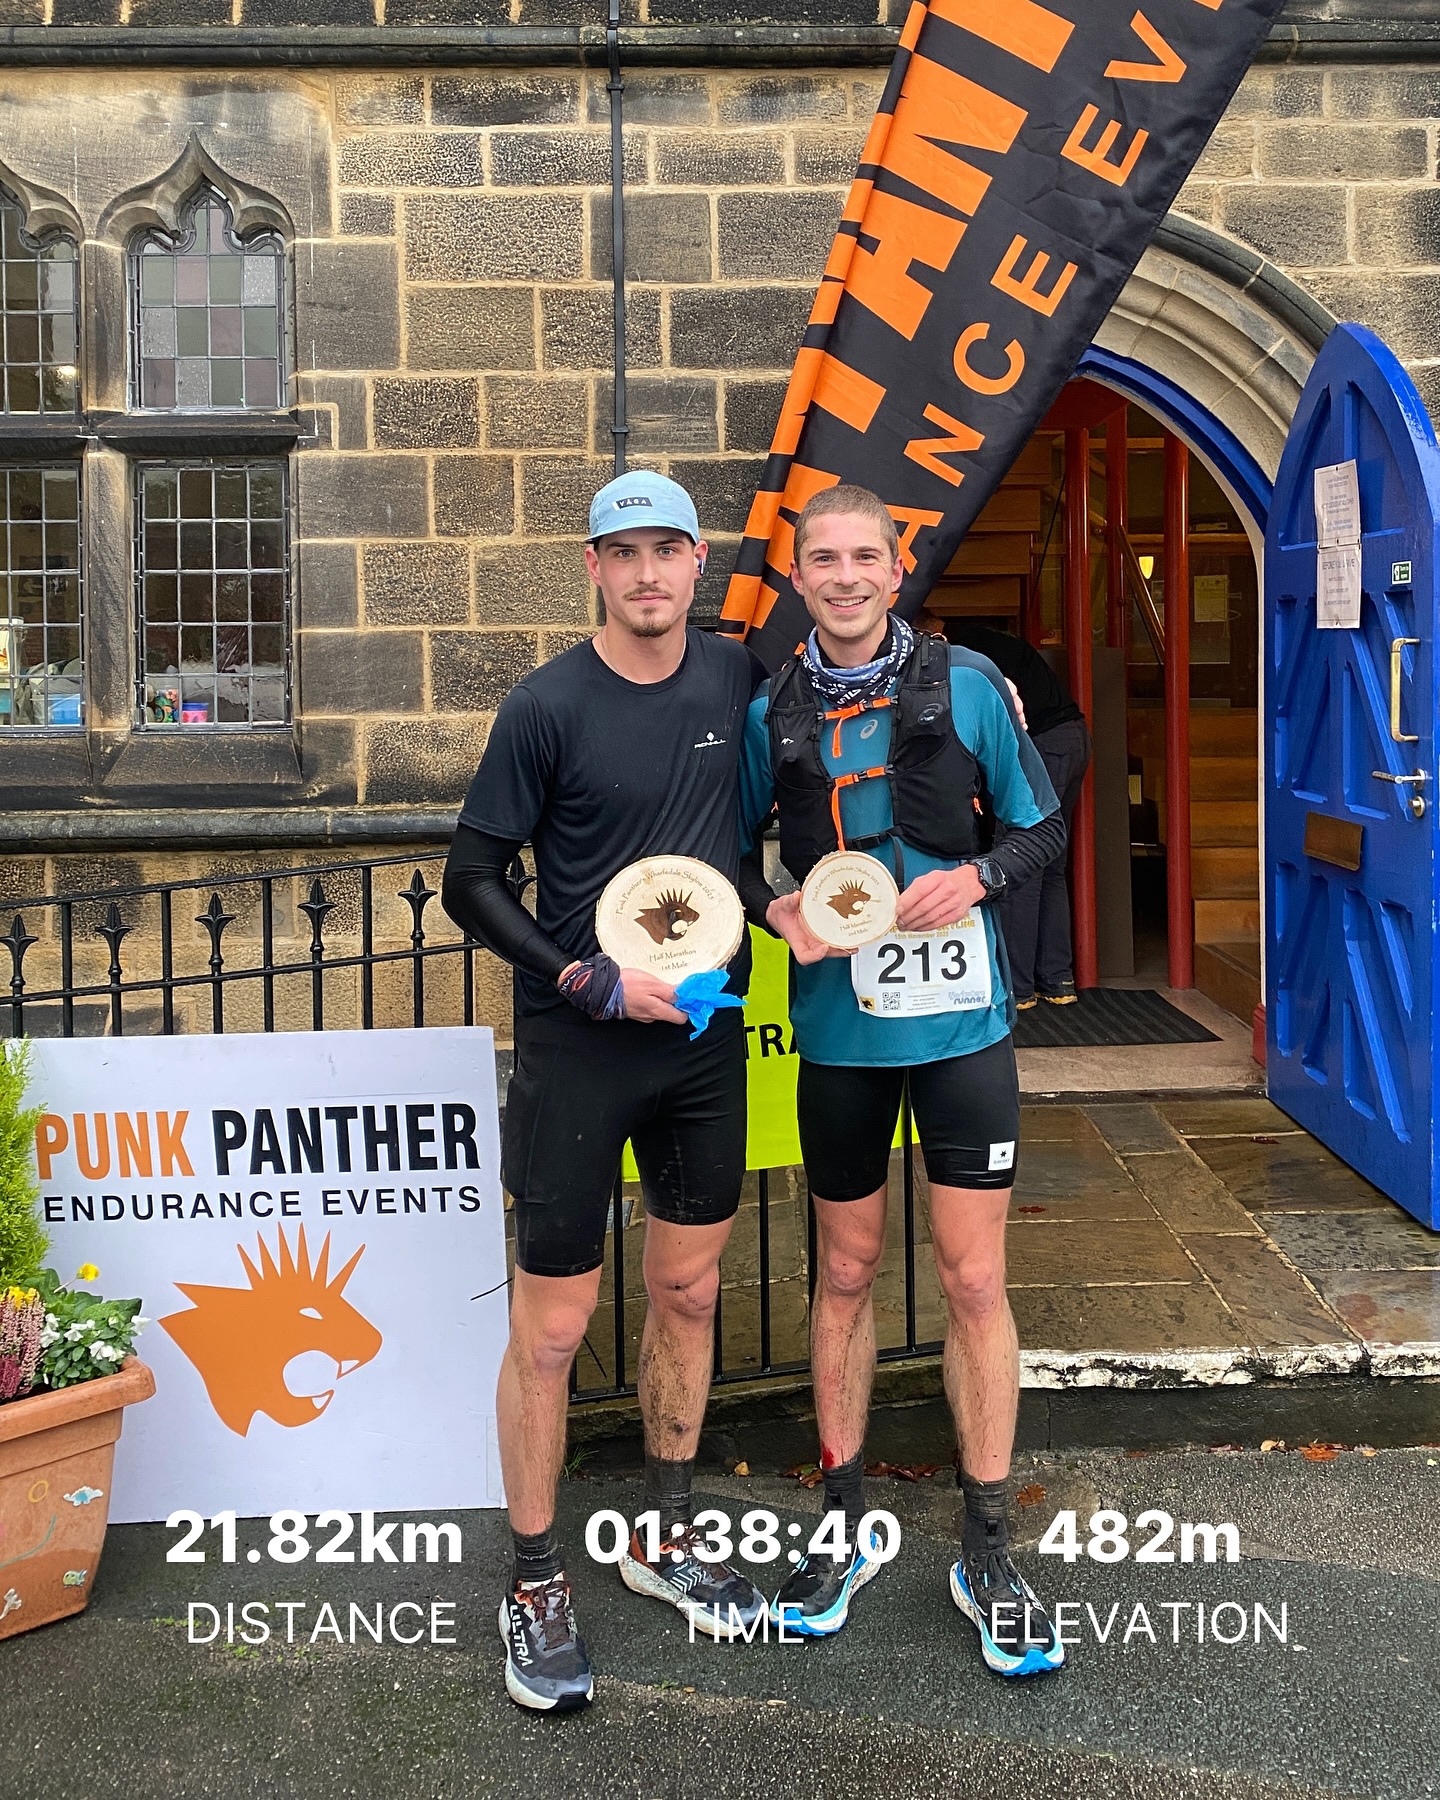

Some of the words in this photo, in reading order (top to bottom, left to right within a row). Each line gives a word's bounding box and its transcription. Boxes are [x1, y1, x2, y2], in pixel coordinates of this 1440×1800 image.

[889, 233, 1078, 607] ANCE
[1061, 0, 1224, 187] EV
[649, 952, 664, 964] Half
[664, 948, 697, 960] Marathon
[671, 960, 688, 970] Male
[877, 938, 967, 985] 213
[37, 1110, 196, 1180] PUNK
[212, 1103, 481, 1176] PANTHER
[45, 1190, 303, 1222] ENDURANCE
[322, 1185, 481, 1216] EVENTS
